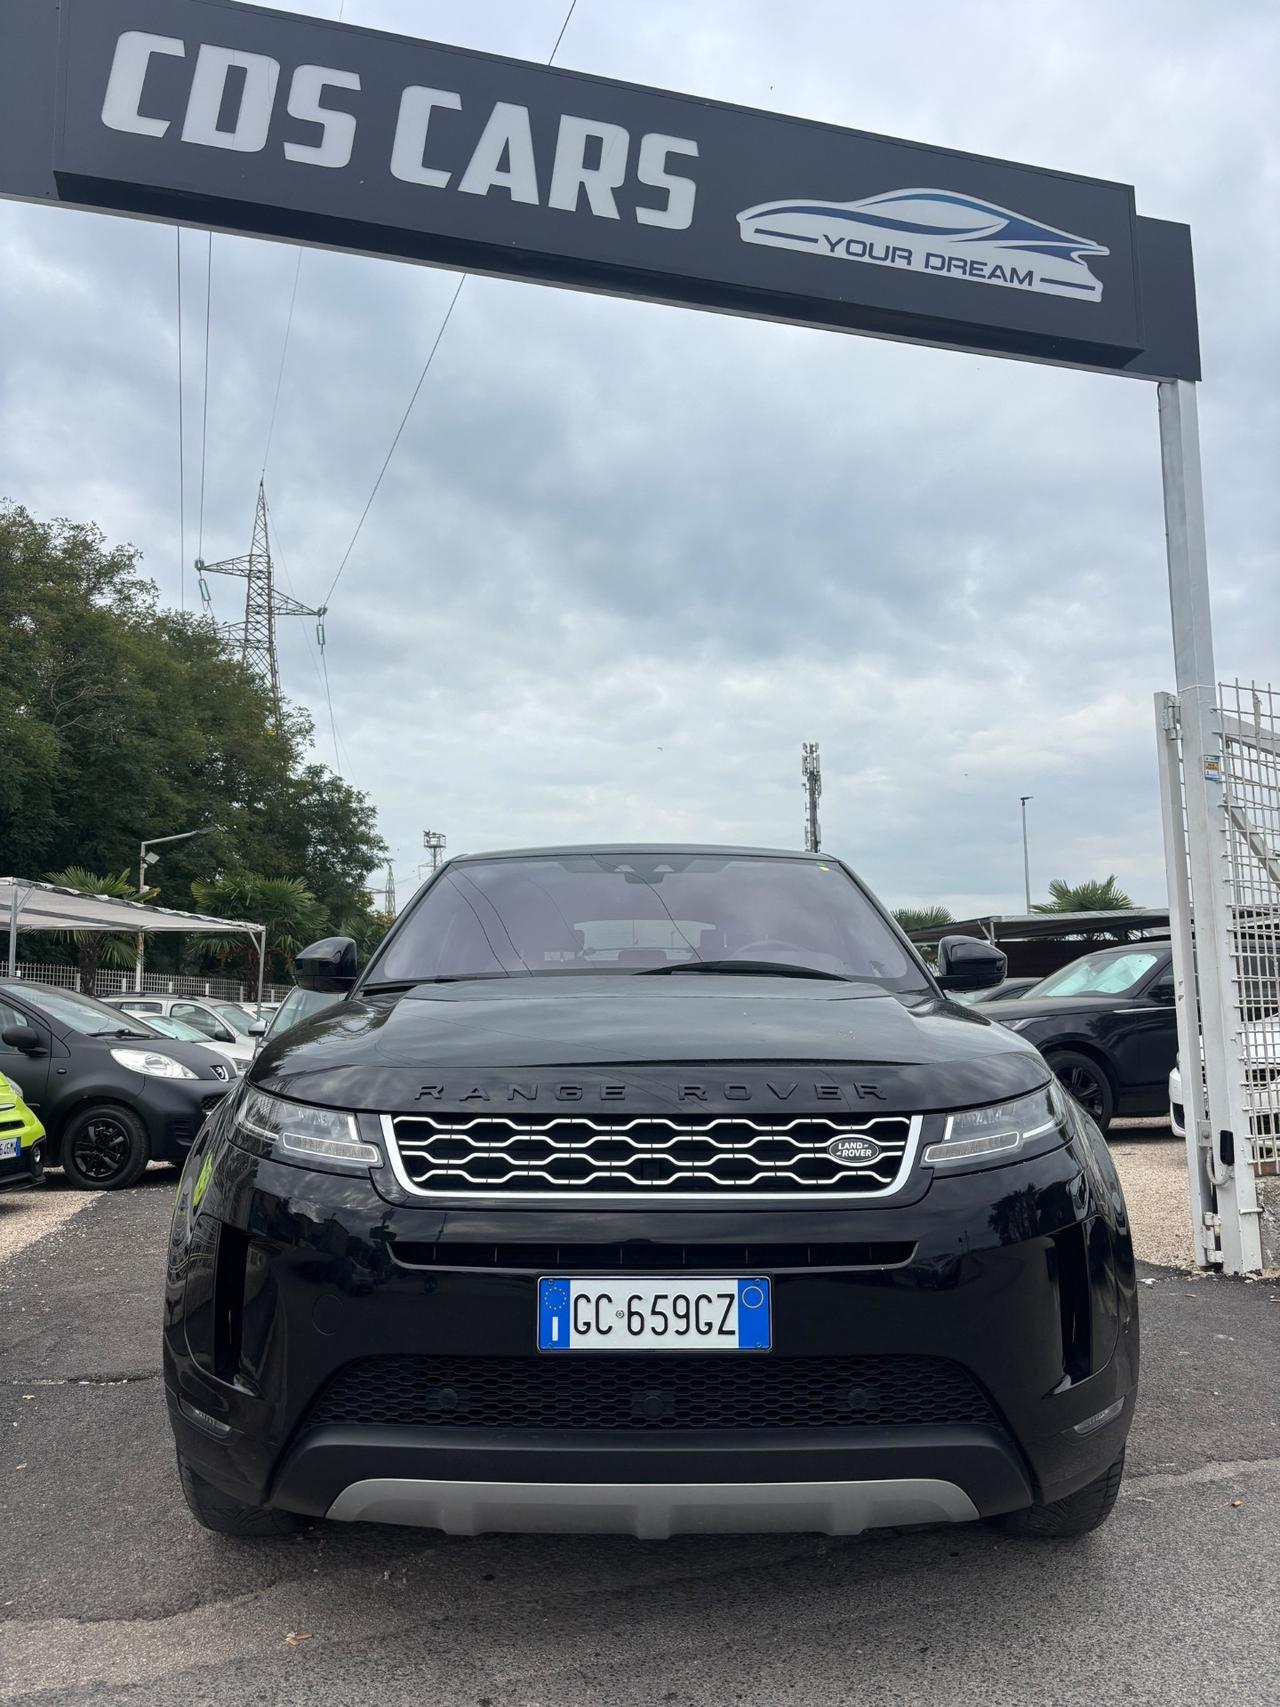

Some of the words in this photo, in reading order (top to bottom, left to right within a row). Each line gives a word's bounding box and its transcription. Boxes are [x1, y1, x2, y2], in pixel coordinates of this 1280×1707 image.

[101, 30, 361, 168] CDS
[390, 85, 700, 230] CARS
[822, 234, 913, 266] YOUR
[924, 252, 1034, 287] DREAM
[414, 1084, 627, 1101] RANGE
[678, 1083, 887, 1101] ROVER
[842, 1149, 872, 1157] ROVER
